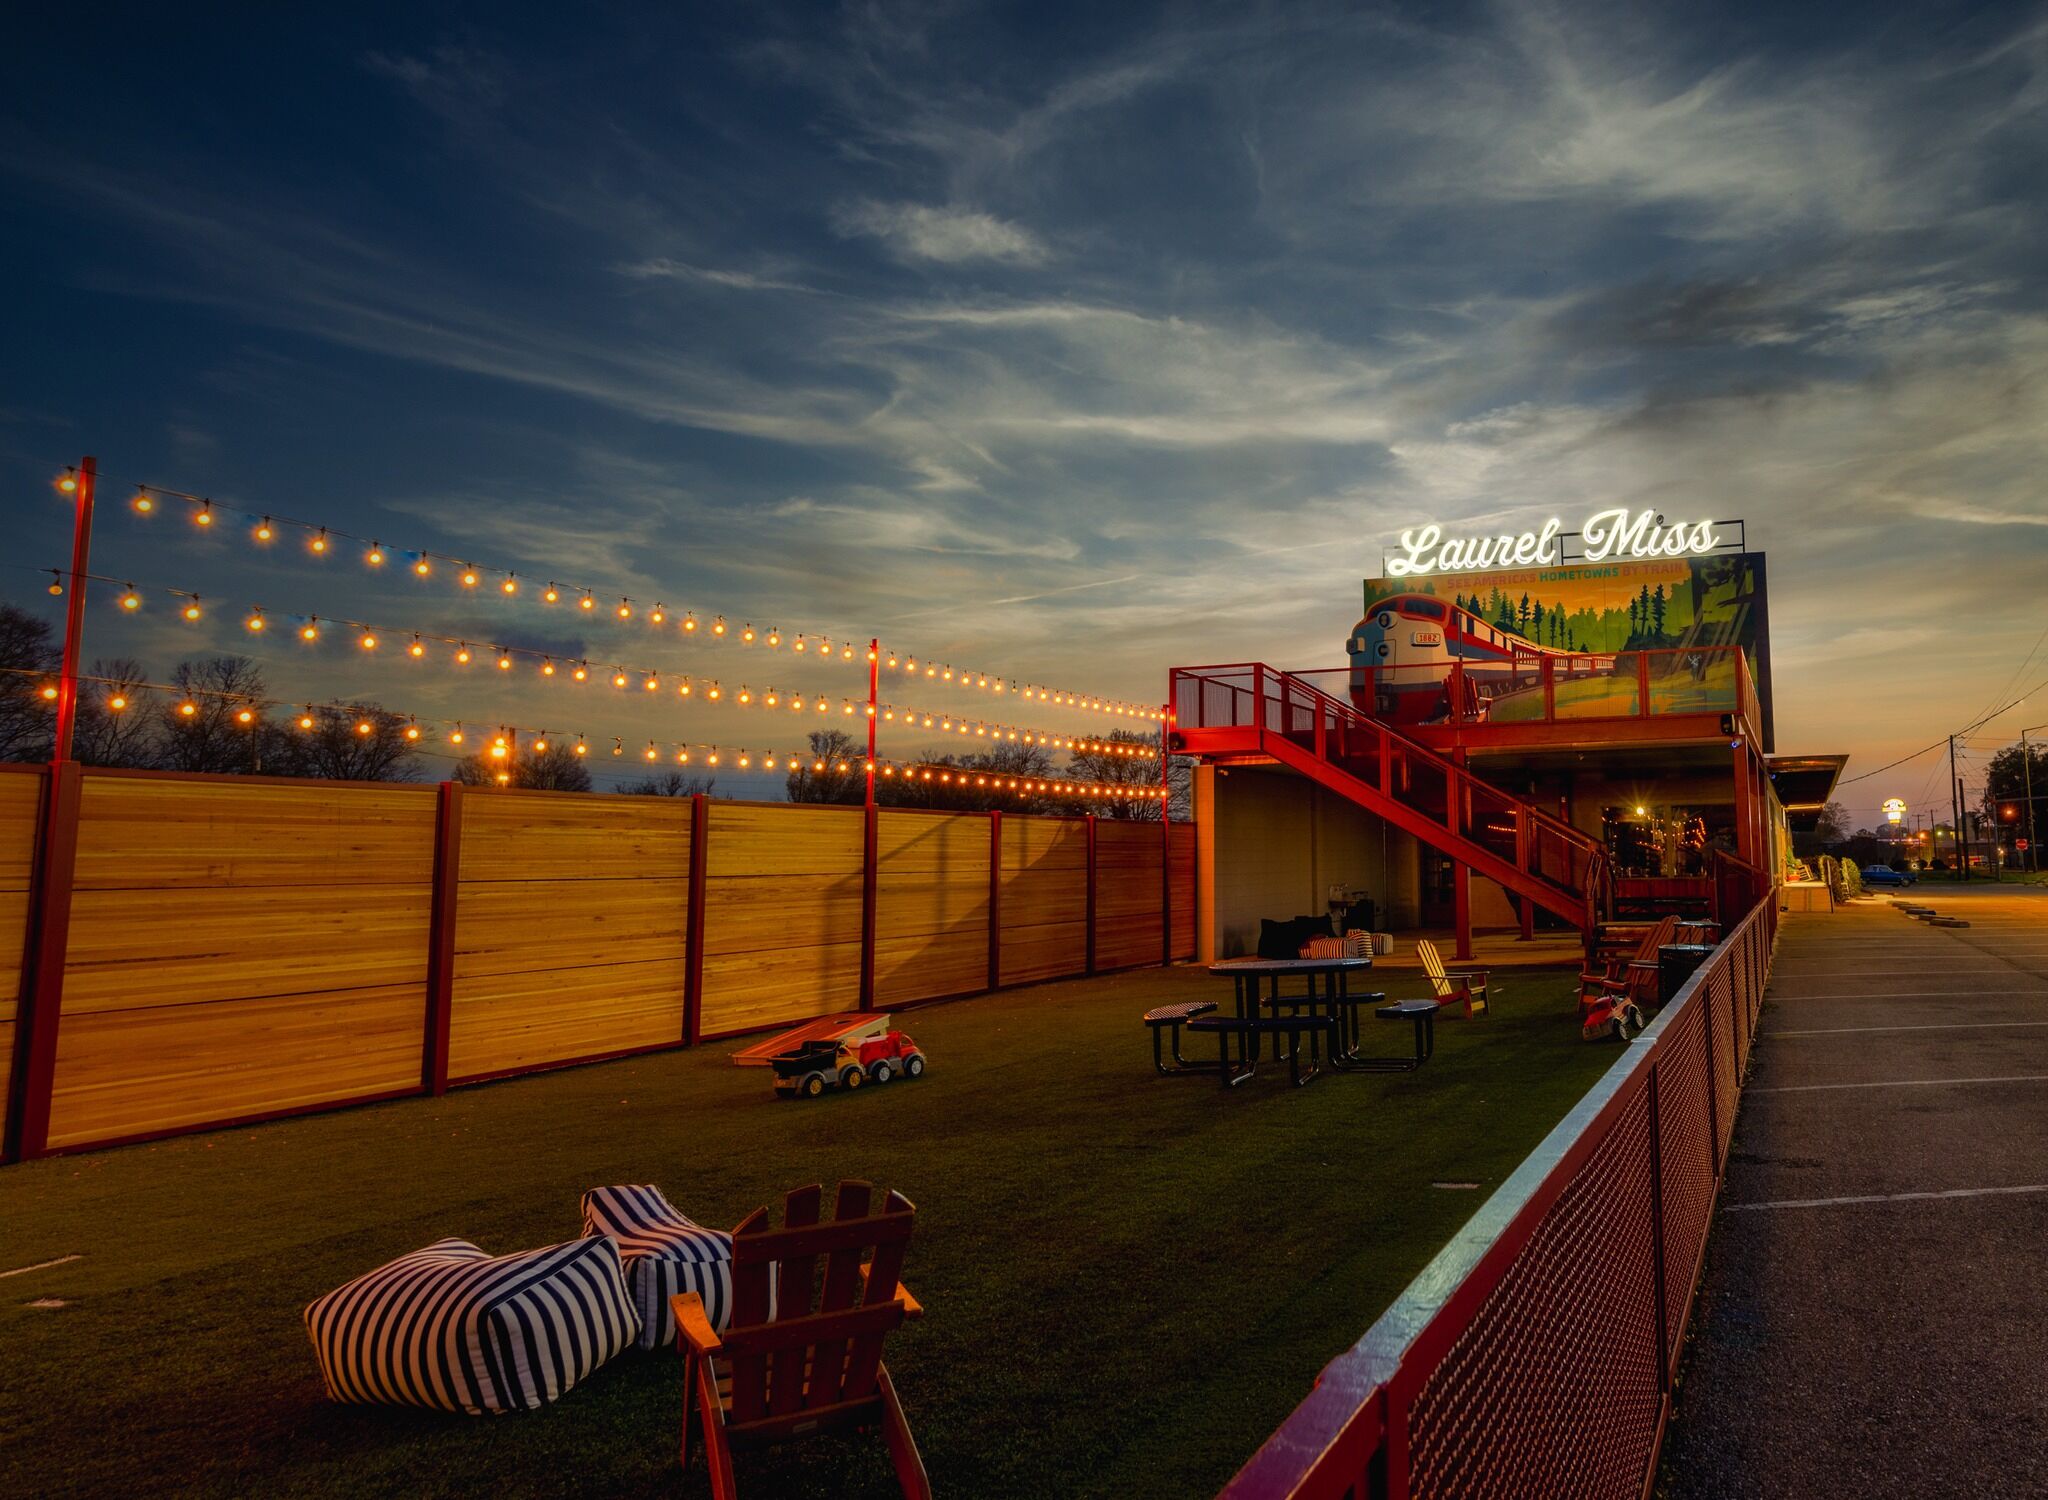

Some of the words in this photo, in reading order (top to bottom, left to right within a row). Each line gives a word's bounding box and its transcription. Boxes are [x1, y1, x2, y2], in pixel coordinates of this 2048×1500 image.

[1387, 518, 1561, 576] Laurel
[1582, 508, 1720, 562] Miss
[1447, 578, 1473, 589] SEE
[1539, 567, 1619, 582] HOMETOWNS
[1622, 566, 1639, 577] BY
[1642, 562, 1683, 575] TRAIN
[1419, 633, 1437, 643] 1882
